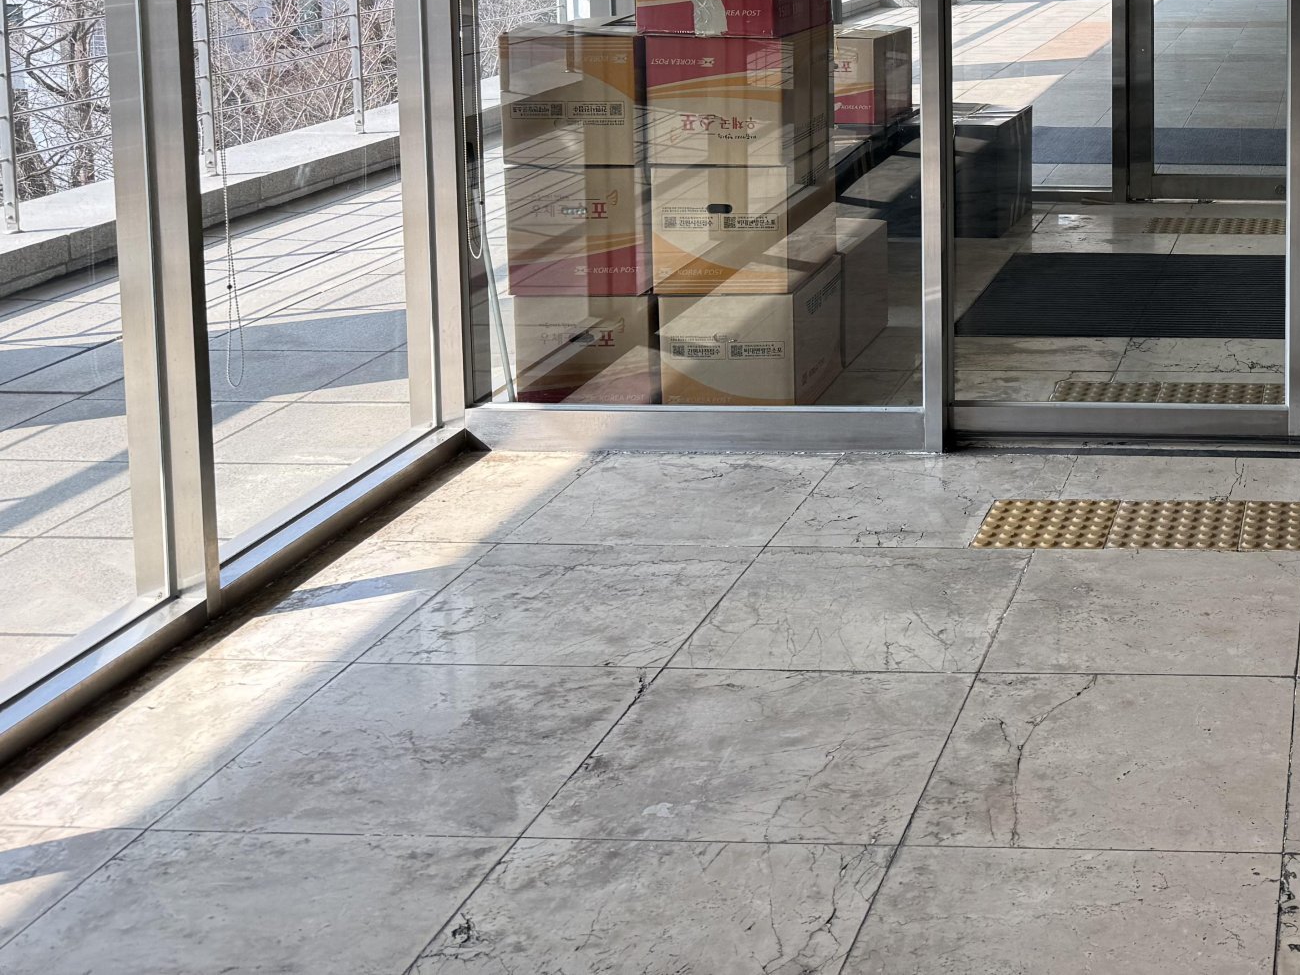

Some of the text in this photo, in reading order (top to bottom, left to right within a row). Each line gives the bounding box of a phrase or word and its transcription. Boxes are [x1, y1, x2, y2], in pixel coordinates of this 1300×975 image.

[742, 9, 762, 18] POST
[650, 57, 696, 67] KOREA POST
[593, 266, 619, 274] KOREA
[678, 268, 702, 276] KOREA
